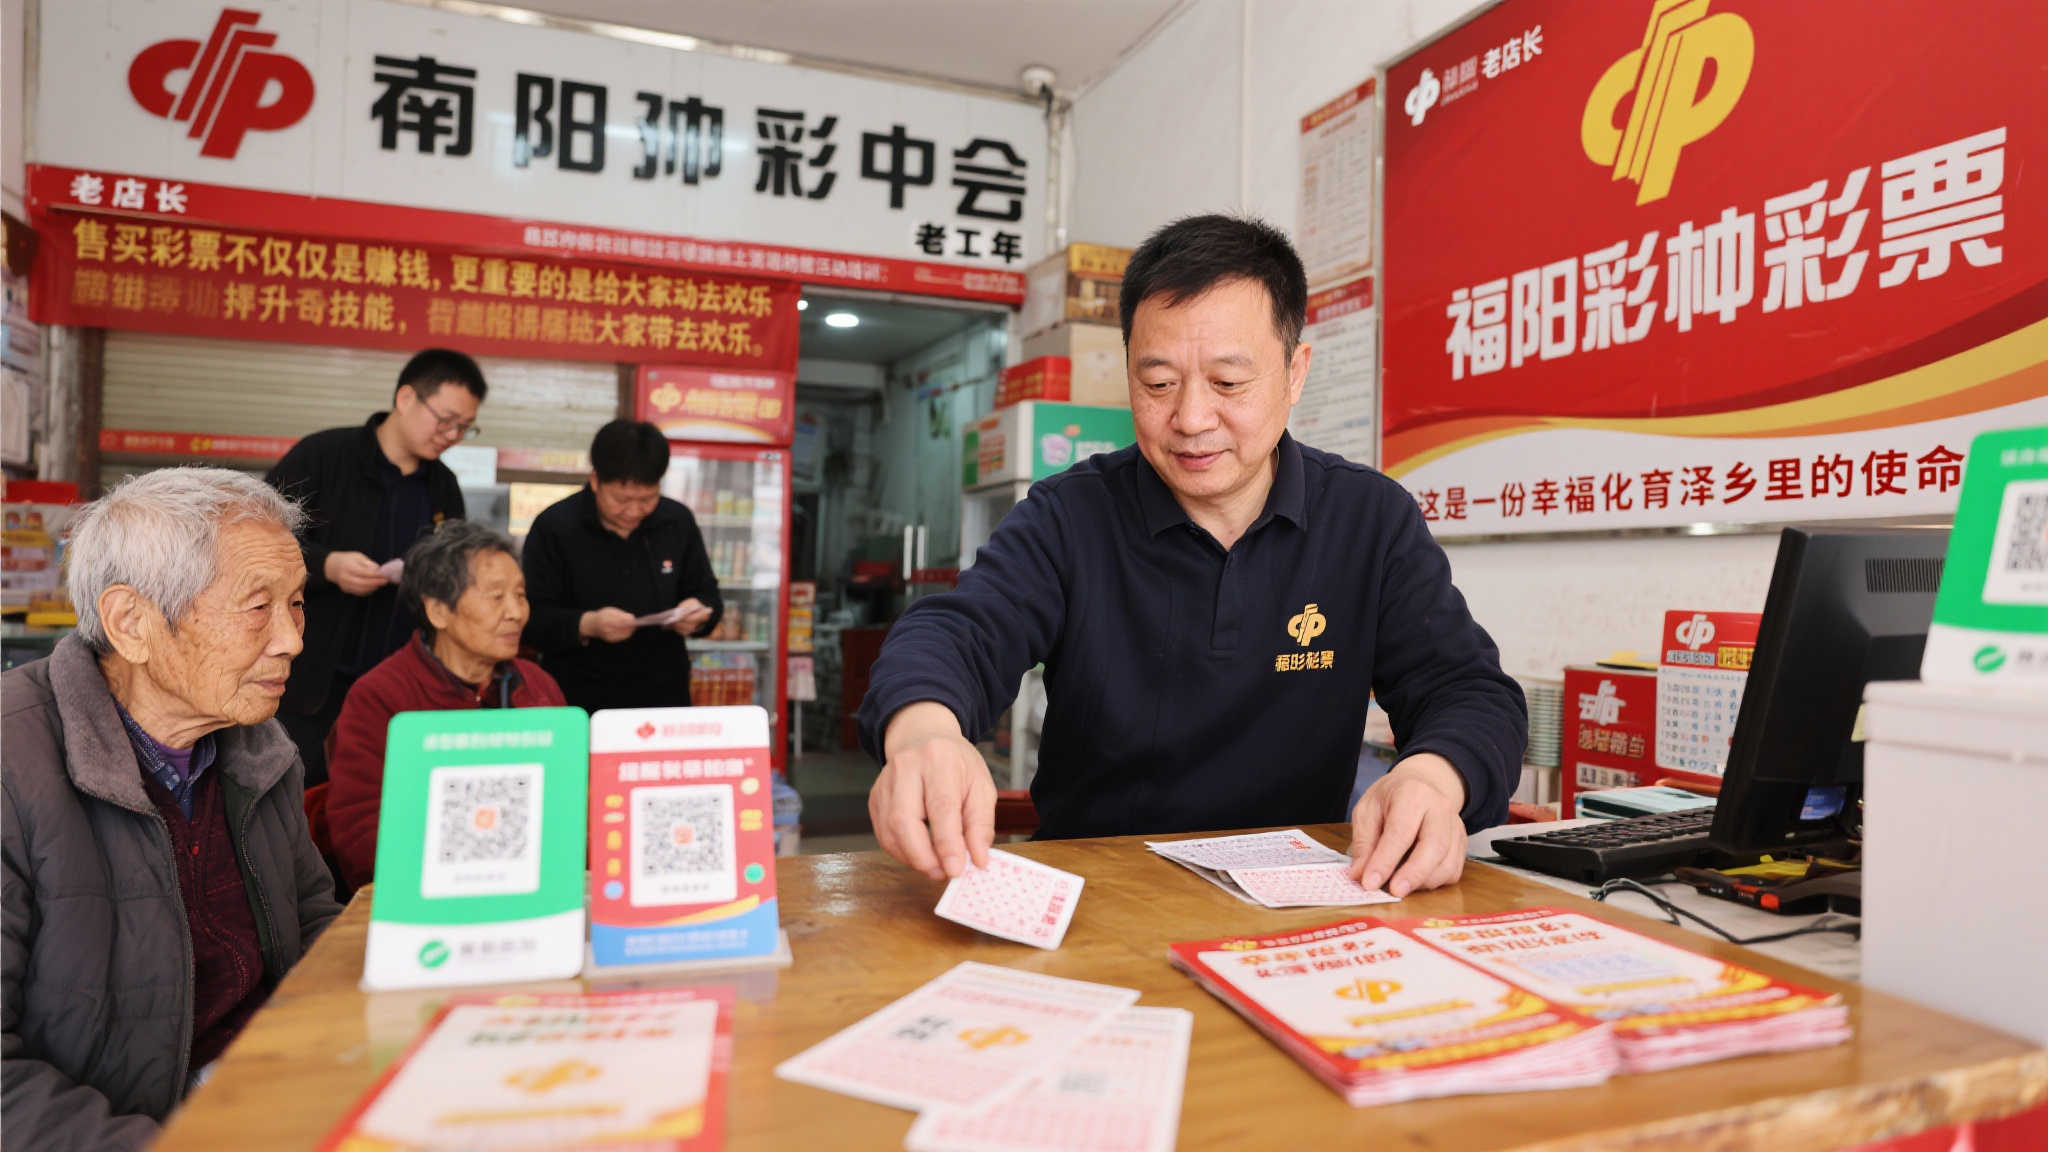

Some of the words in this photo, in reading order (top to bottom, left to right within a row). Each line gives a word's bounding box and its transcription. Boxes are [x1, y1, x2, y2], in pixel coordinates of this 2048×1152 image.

[1482, 25, 1544, 79] 老店长
[70, 173, 188, 214] 老店长
[915, 222, 1022, 264] 老工年
[1418, 444, 1966, 521] 这是一份幸福化育泽乡里的使命
